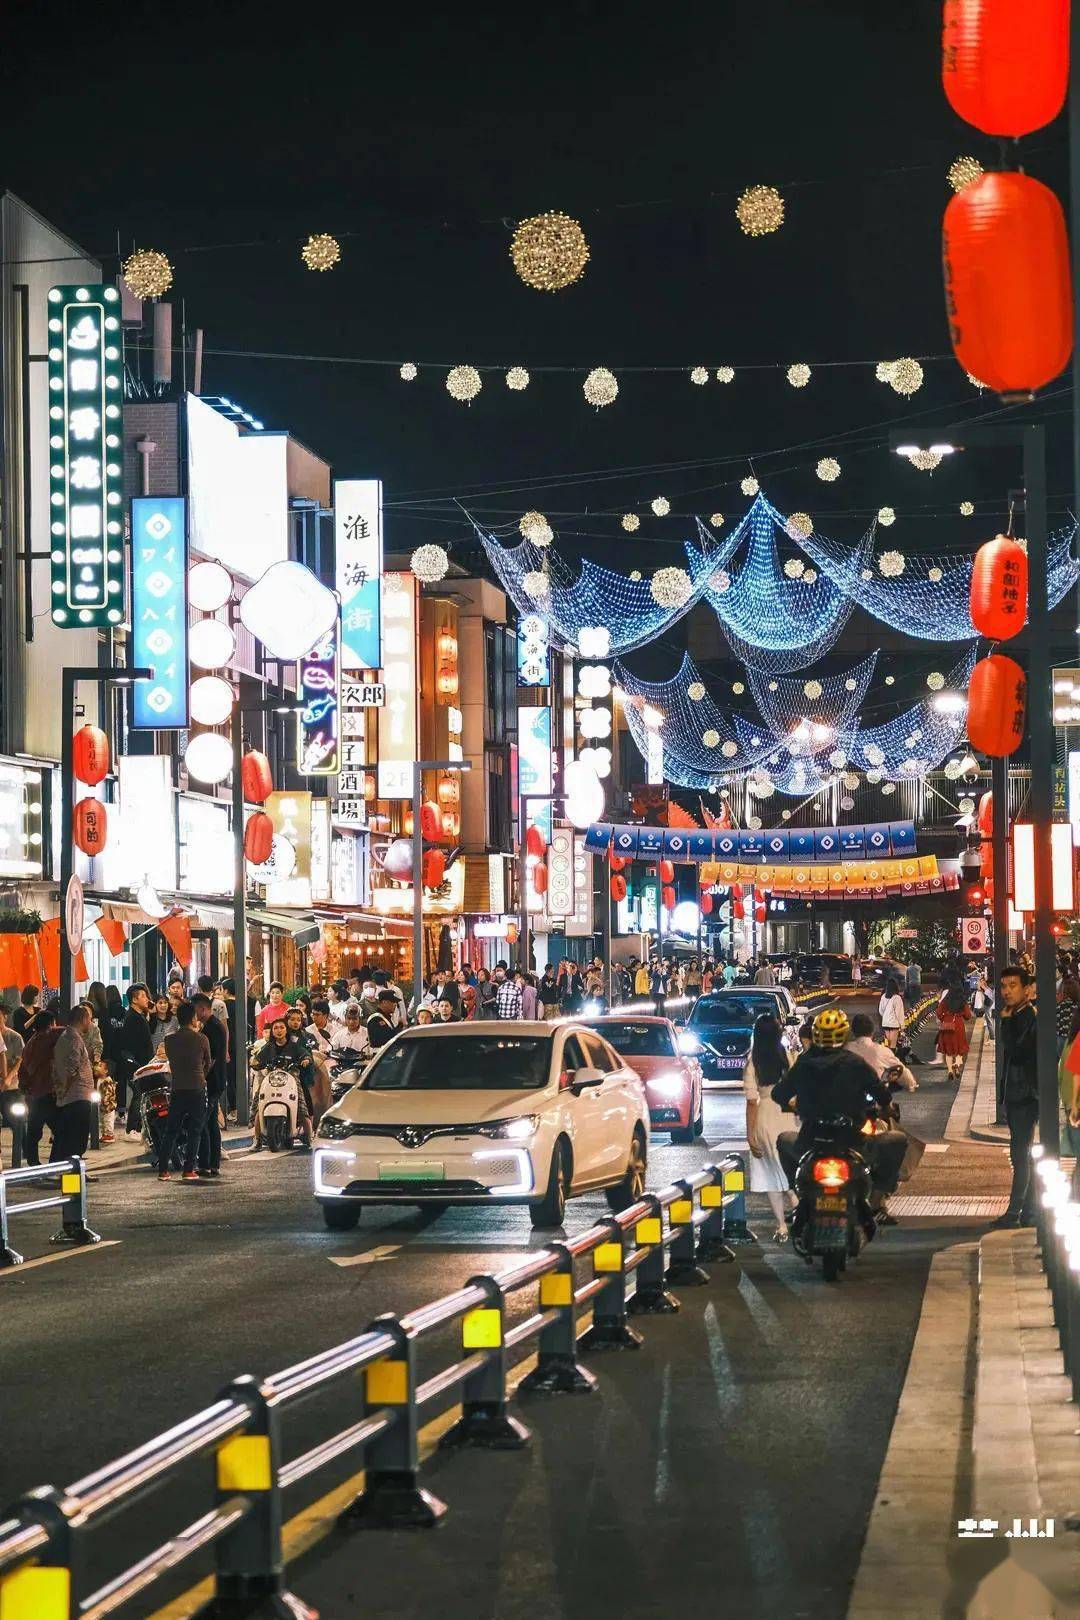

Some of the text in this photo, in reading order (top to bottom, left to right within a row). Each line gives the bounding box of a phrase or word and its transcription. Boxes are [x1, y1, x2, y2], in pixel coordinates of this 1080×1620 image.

[343, 514, 373, 632] 淮海街
[527, 621, 540, 676] 淮海街
